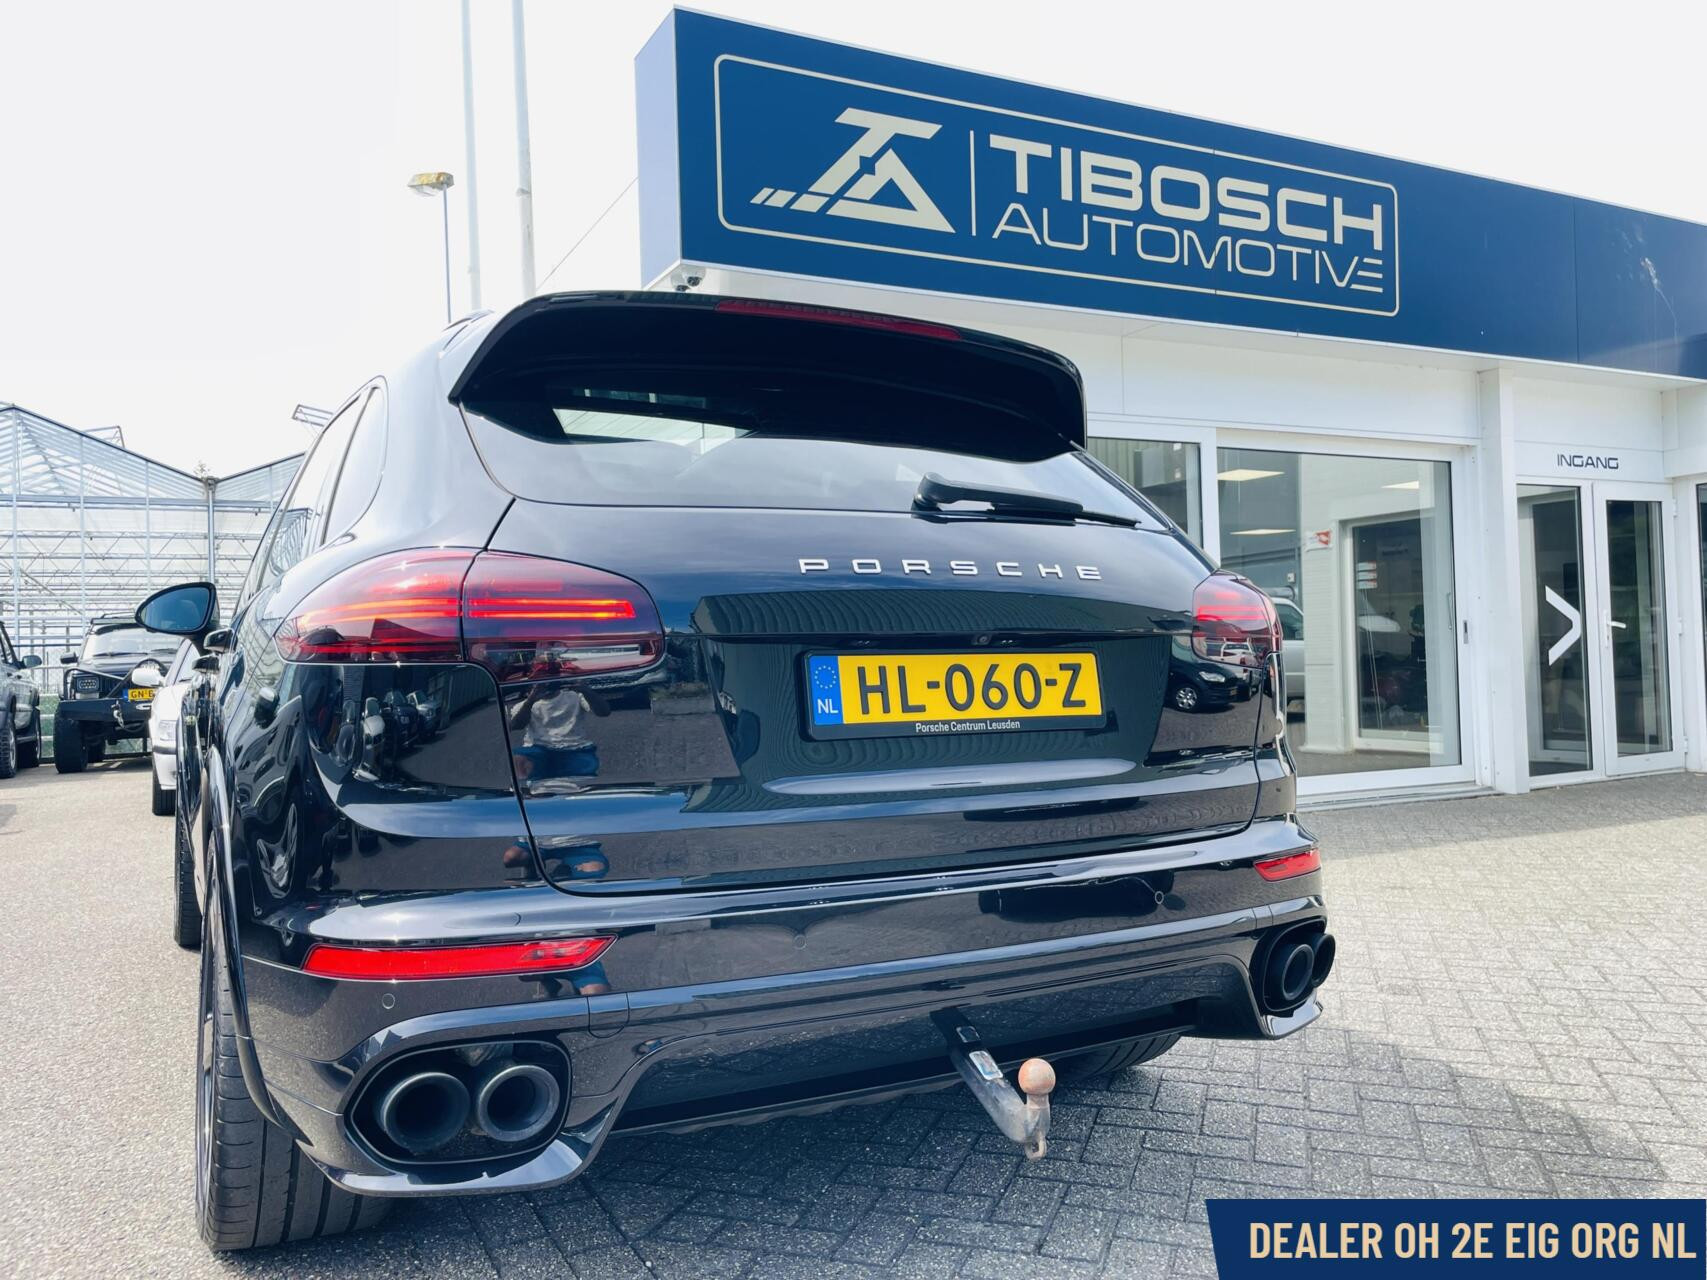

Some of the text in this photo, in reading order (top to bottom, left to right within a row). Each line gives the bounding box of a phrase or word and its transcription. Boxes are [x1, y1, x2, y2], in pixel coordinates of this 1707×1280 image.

[989, 133, 1384, 251] TIBOSCH
[991, 202, 1384, 293] AUTOMOTIVE
[1557, 453, 1619, 470] INGANG
[798, 558, 1102, 580] PORSCHE
[857, 662, 1087, 715] HL-060-Z
[817, 698, 839, 715] NL
[915, 719, 1021, 733] Porsche Centrum Leusden
